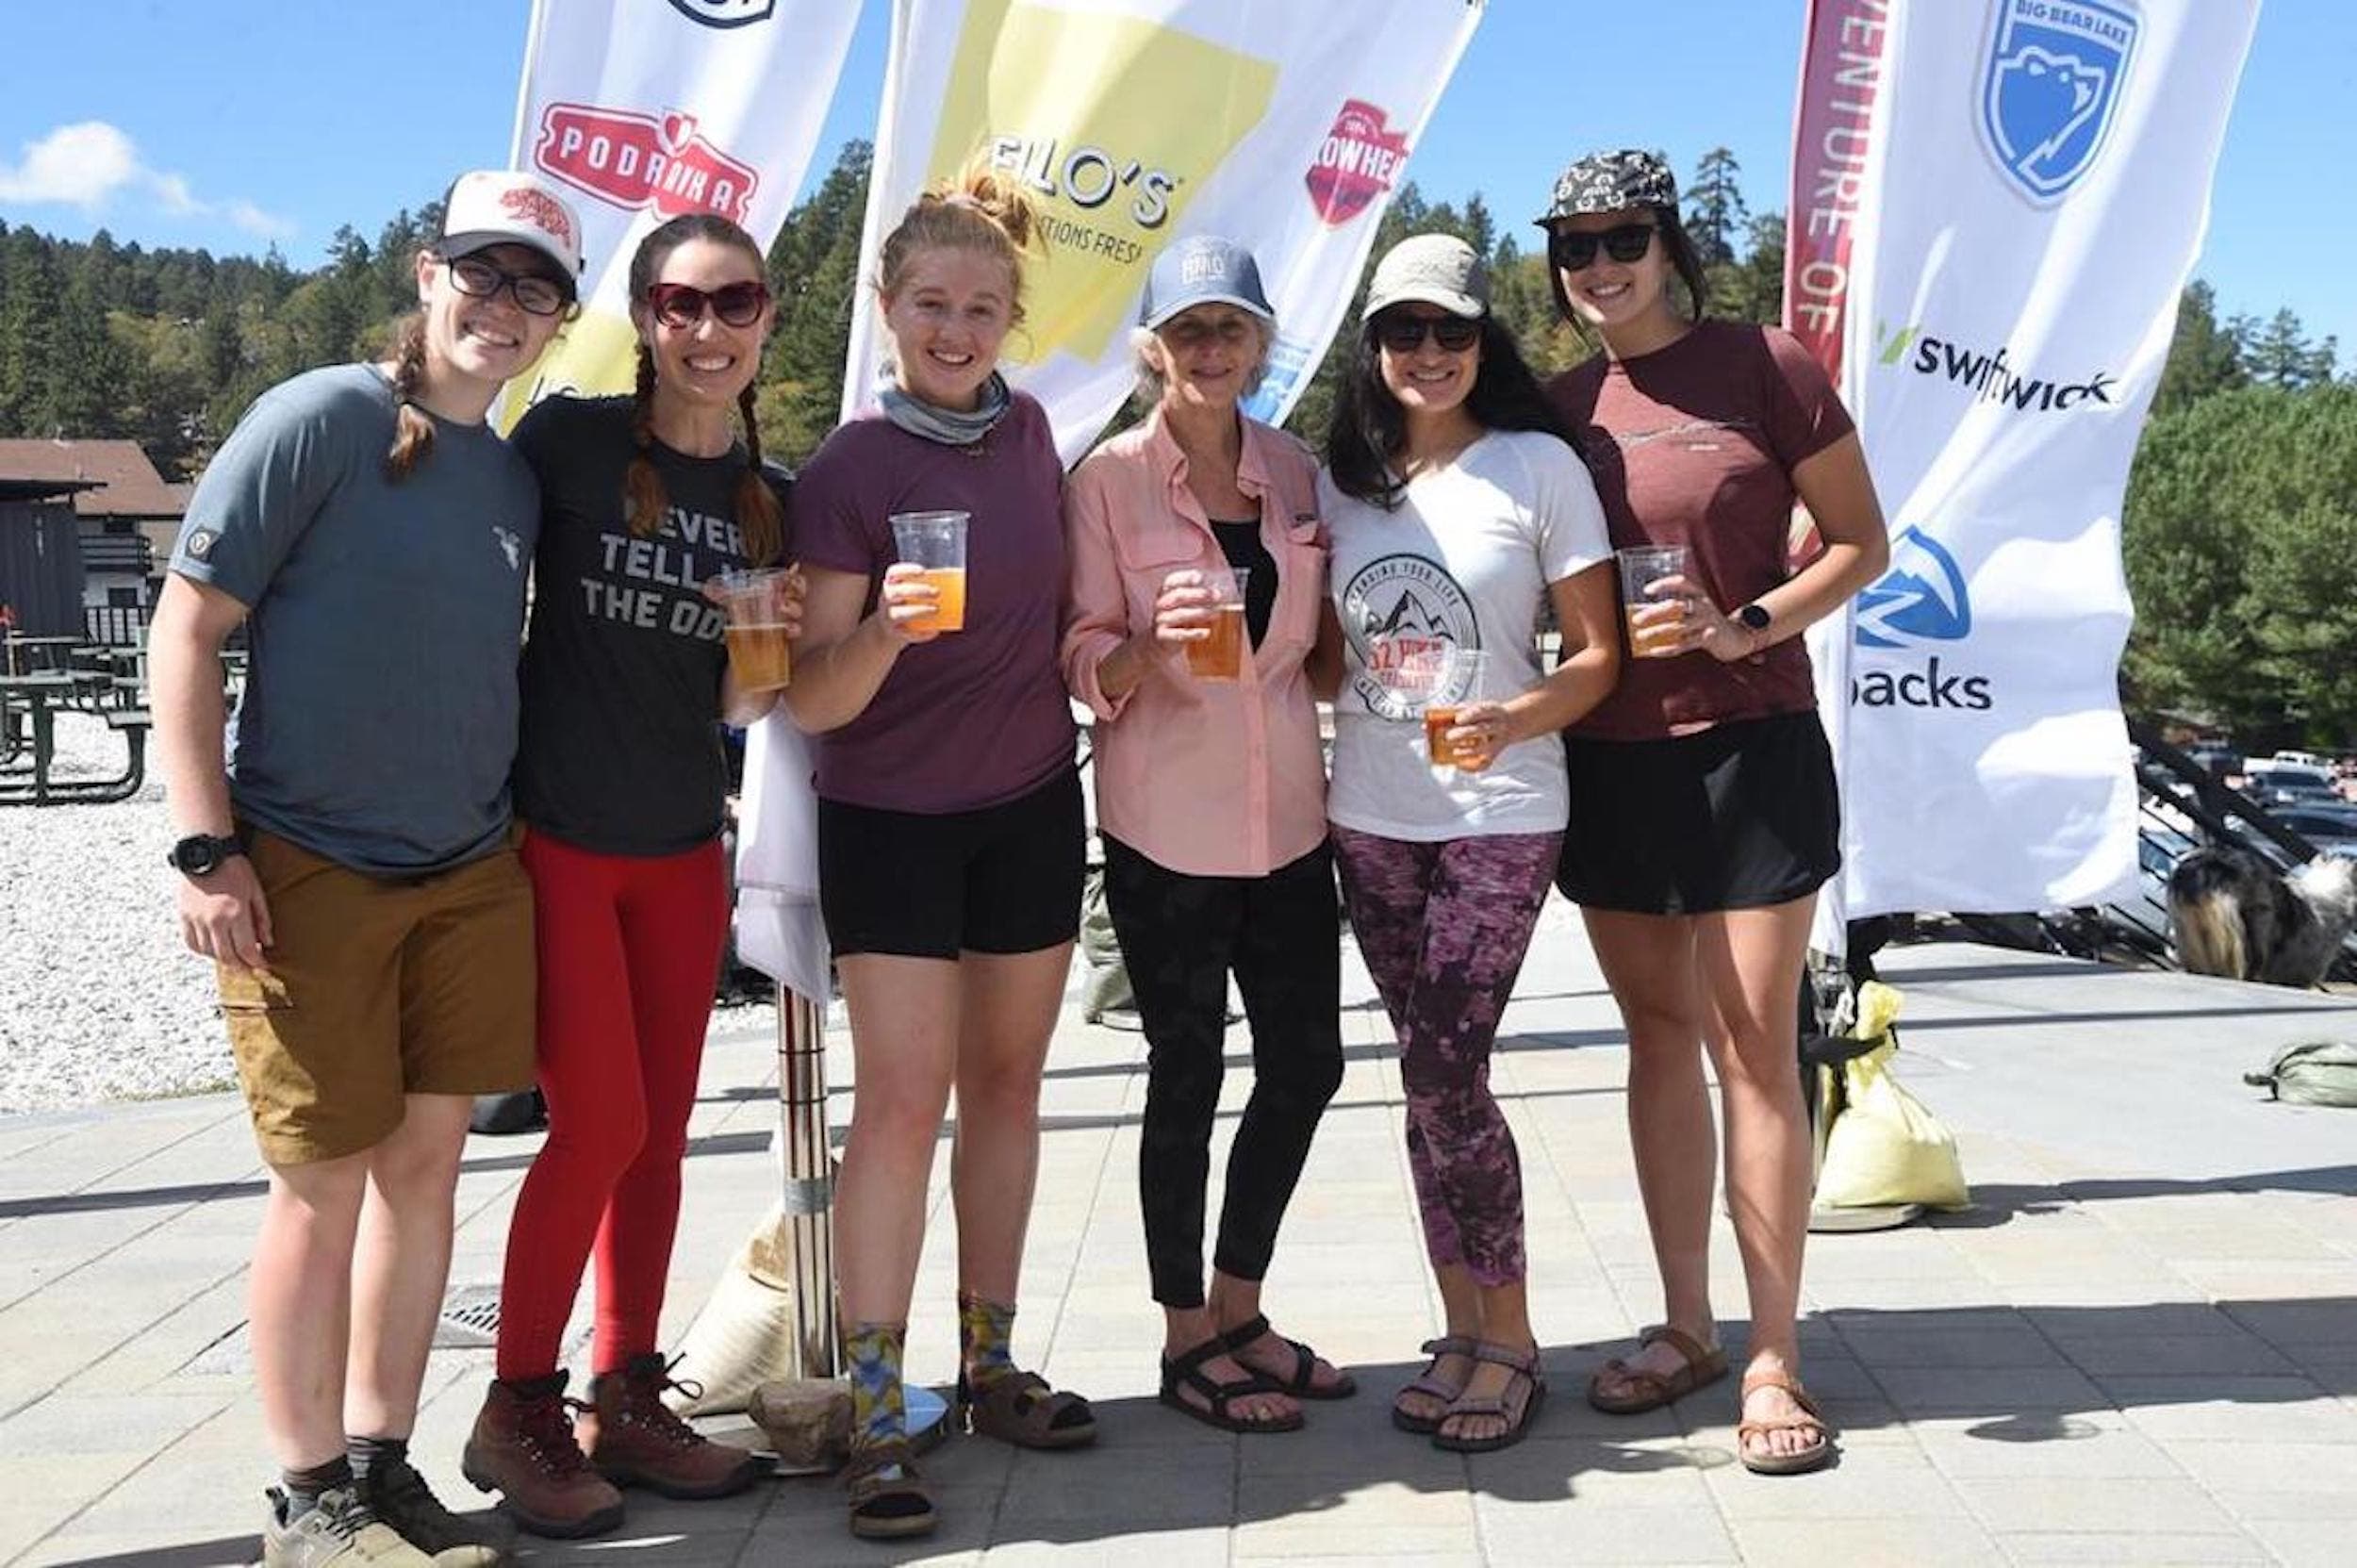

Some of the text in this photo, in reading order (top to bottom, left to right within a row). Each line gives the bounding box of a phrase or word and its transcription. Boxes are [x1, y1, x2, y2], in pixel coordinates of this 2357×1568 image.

[2016, 0, 2048, 18] BIG
[1797, 0, 1887, 335] ENTURE OF
[1040, 216, 1094, 252] TIONS
[623, 498, 748, 556] EVER
[600, 533, 705, 590] TELL
[581, 577, 727, 645] THE OD
